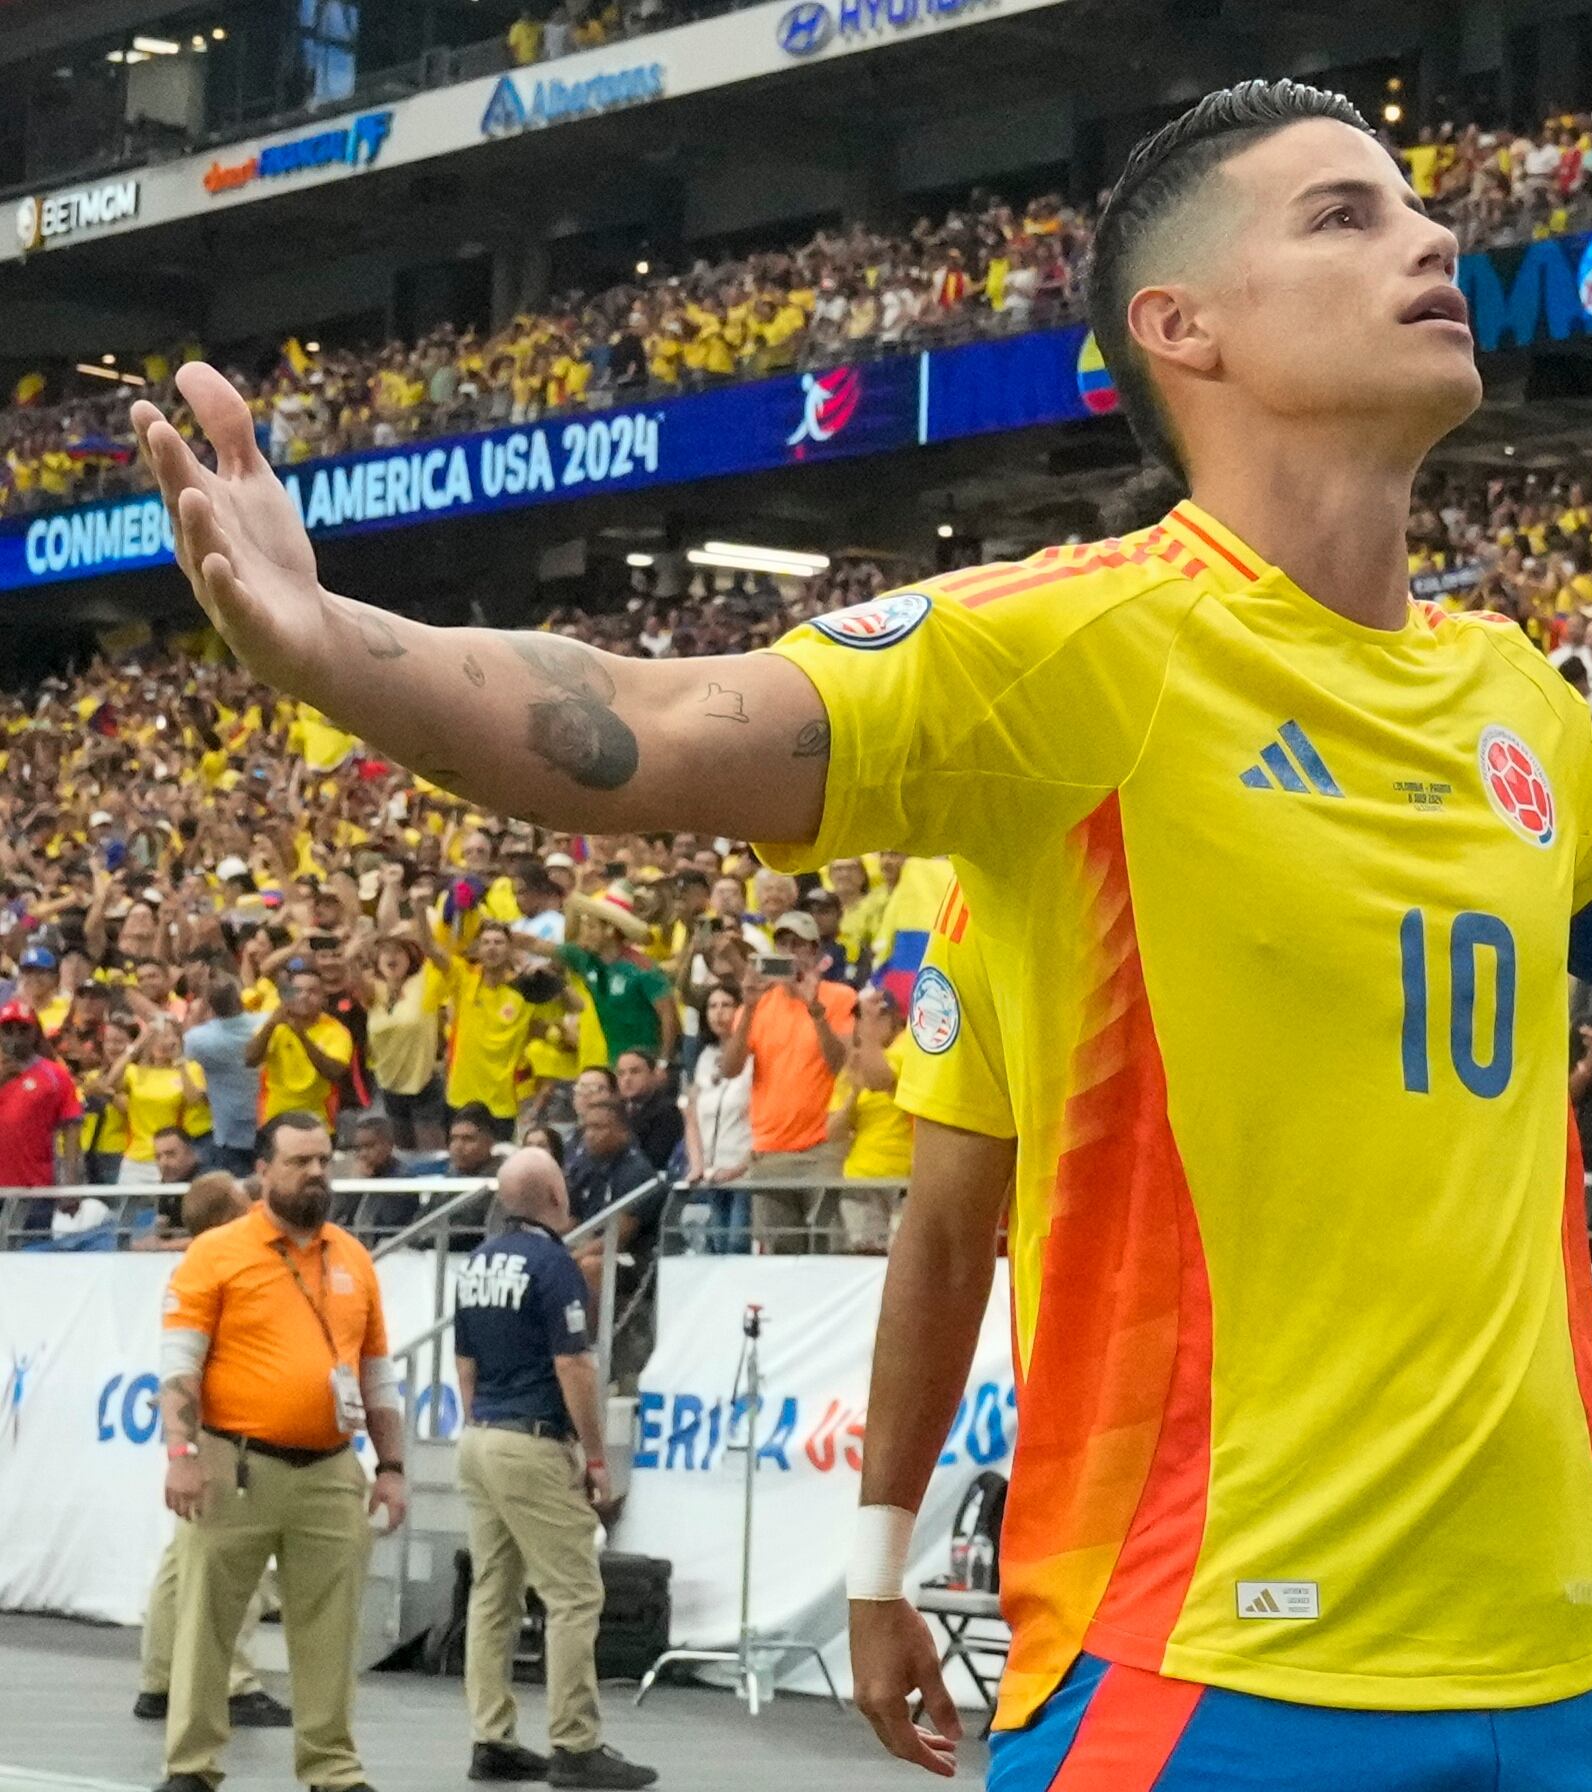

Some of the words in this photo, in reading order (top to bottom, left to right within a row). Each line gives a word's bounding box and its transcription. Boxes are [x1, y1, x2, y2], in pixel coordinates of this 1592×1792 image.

[41, 180, 139, 237] BETMGM
[26, 497, 176, 575] CONMEBO
[305, 446, 473, 529] AMERICA
[481, 429, 555, 498] USA
[562, 413, 658, 485] 2024
[1401, 908, 1516, 1099] 10
[632, 1392, 798, 1471] ERICA
